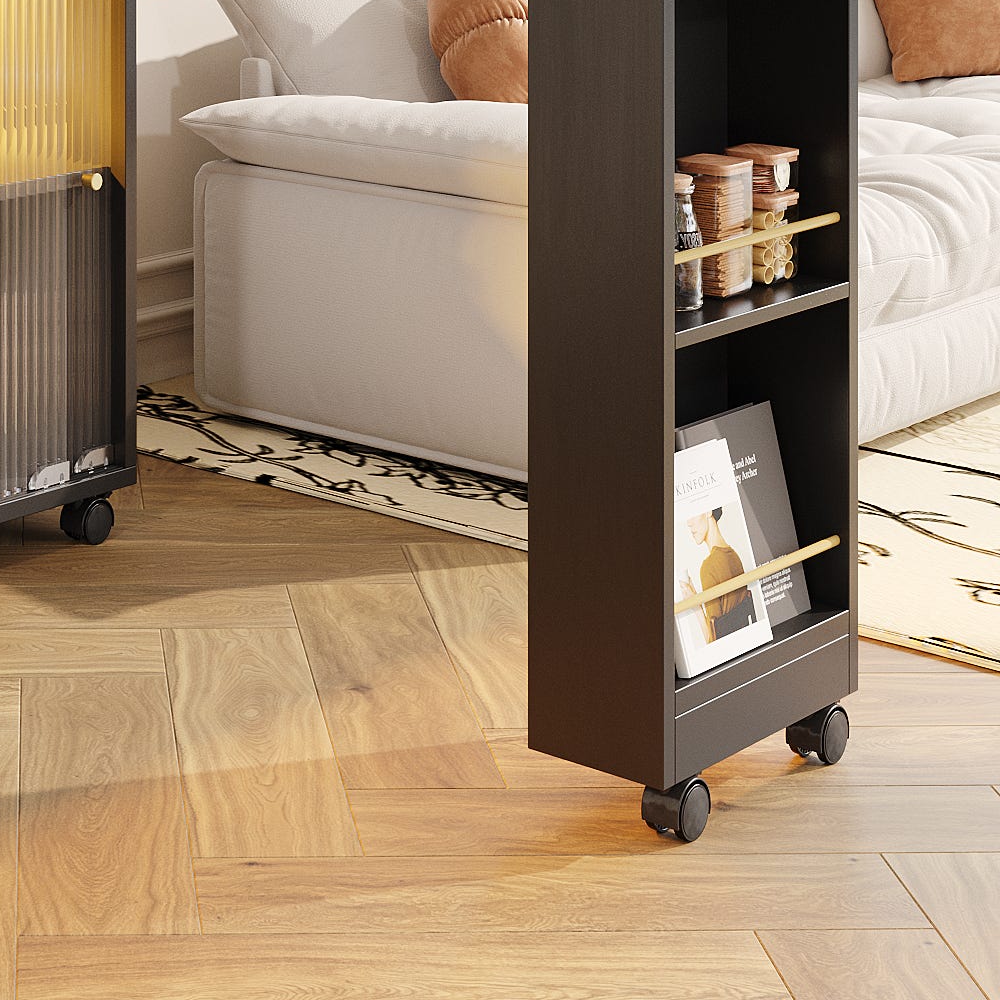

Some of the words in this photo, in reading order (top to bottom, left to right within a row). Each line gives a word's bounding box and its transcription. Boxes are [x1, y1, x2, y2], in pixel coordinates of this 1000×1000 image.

[735, 457, 745, 470] and
[744, 453, 757, 467] Abel
[742, 468, 758, 481] Archer
[676, 471, 717, 497] KINFOLK
